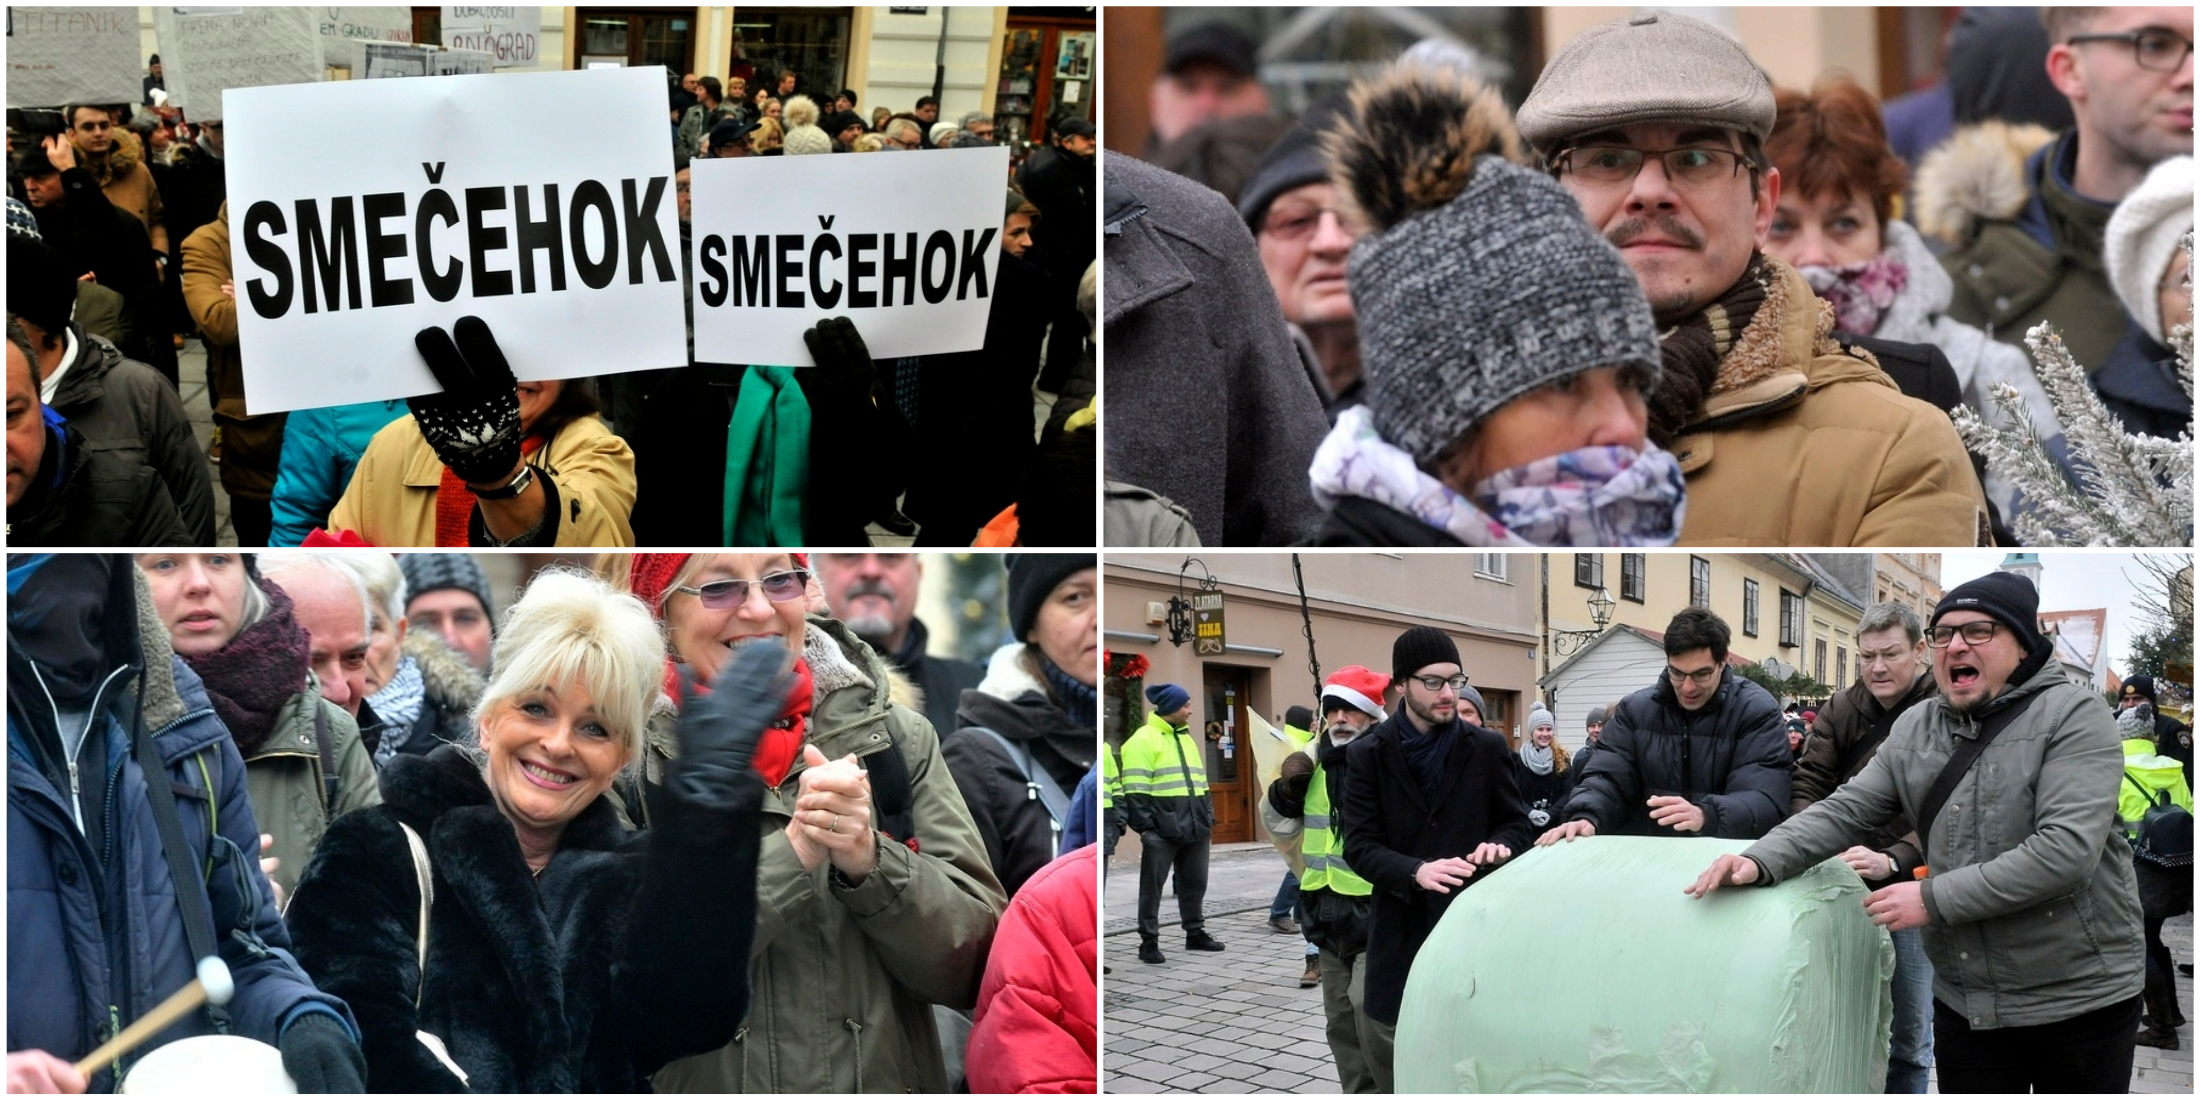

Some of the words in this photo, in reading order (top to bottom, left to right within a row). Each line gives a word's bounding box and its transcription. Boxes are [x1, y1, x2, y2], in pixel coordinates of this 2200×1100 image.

[15, 9, 124, 36] TITANIK
[341, 23, 379, 40] GRADU
[243, 161, 677, 319] SMEČEHOK
[700, 215, 998, 309] SMEČEHOK
